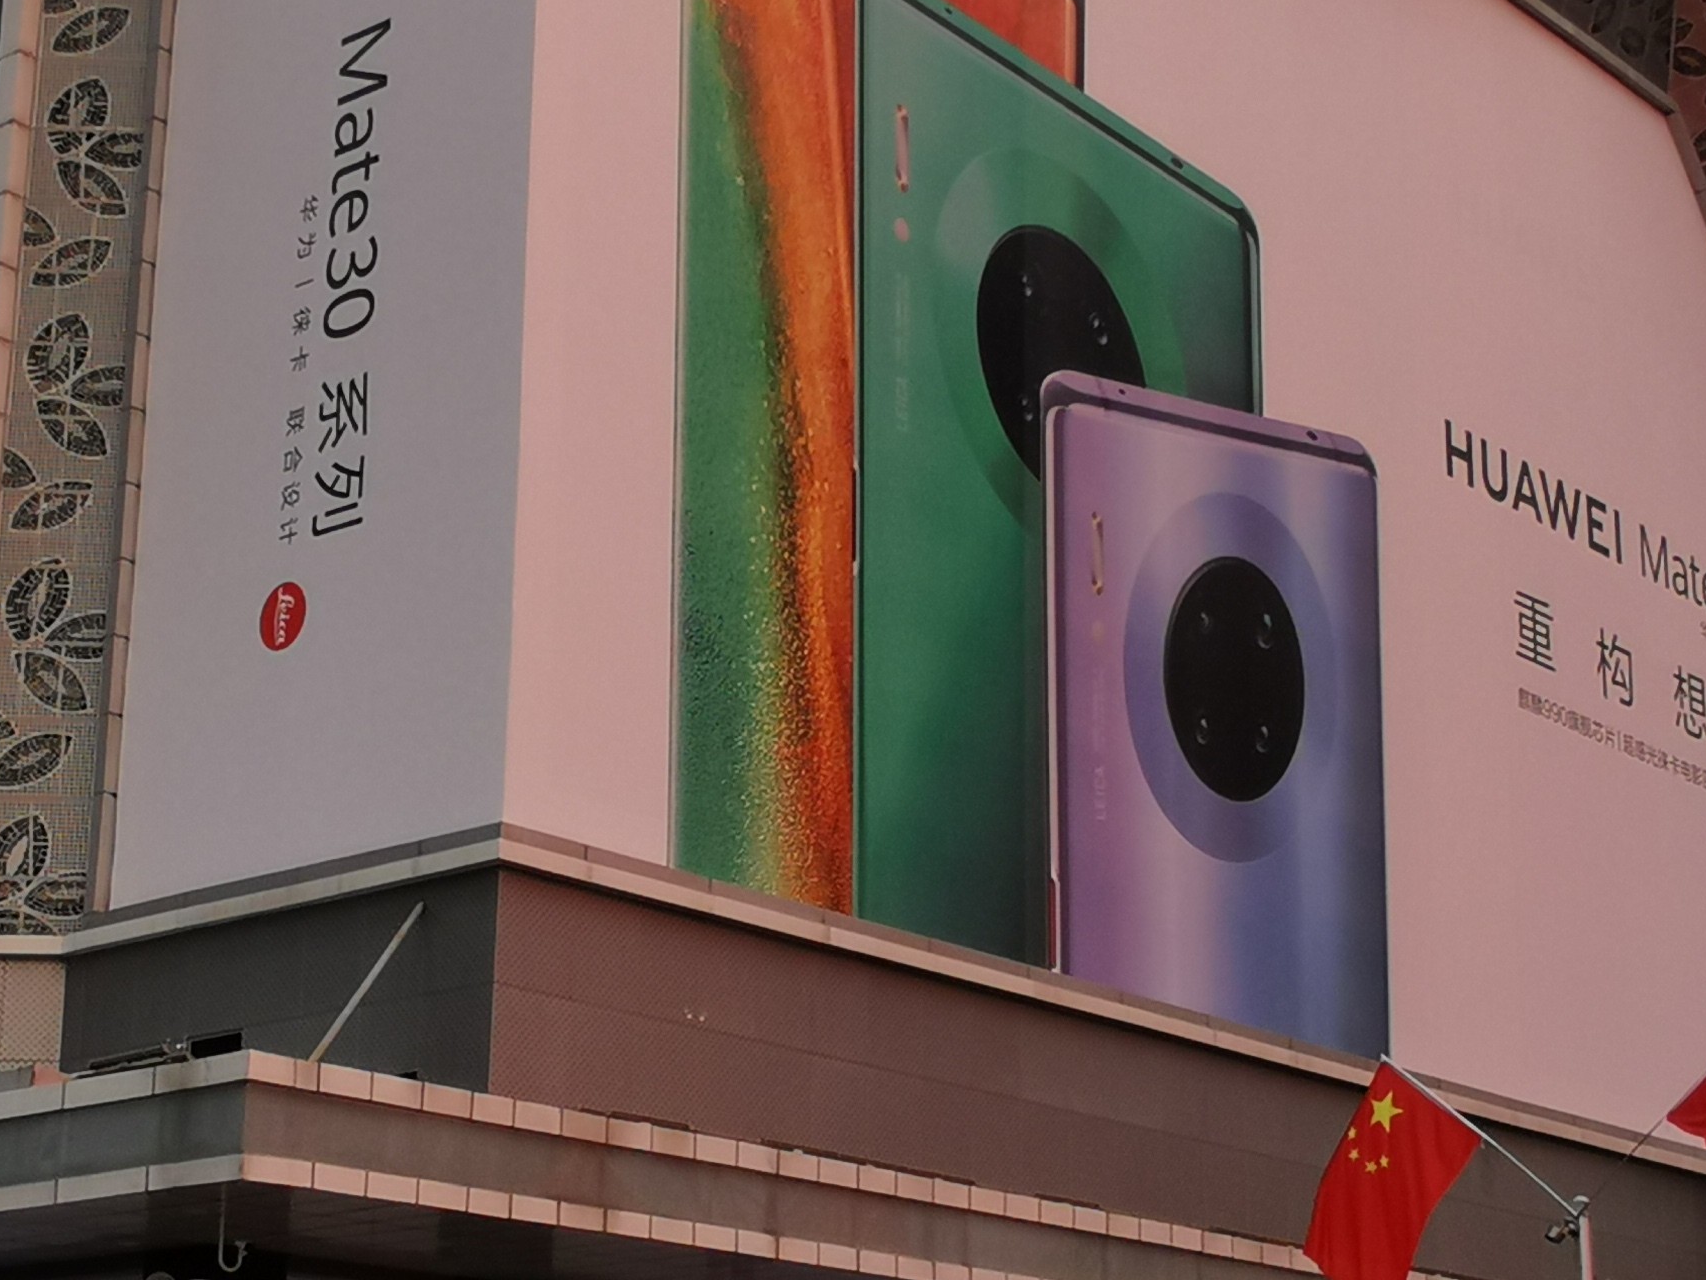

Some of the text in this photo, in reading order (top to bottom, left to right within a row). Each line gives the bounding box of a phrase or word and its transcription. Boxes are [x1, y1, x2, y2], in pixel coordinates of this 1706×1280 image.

[298, 194, 319, 259] 华为
[323, 17, 391, 339] Mate30
[278, 406, 305, 545] 联合设计
[311, 371, 368, 537] 系列
[1443, 418, 1623, 565] HUAWEI
